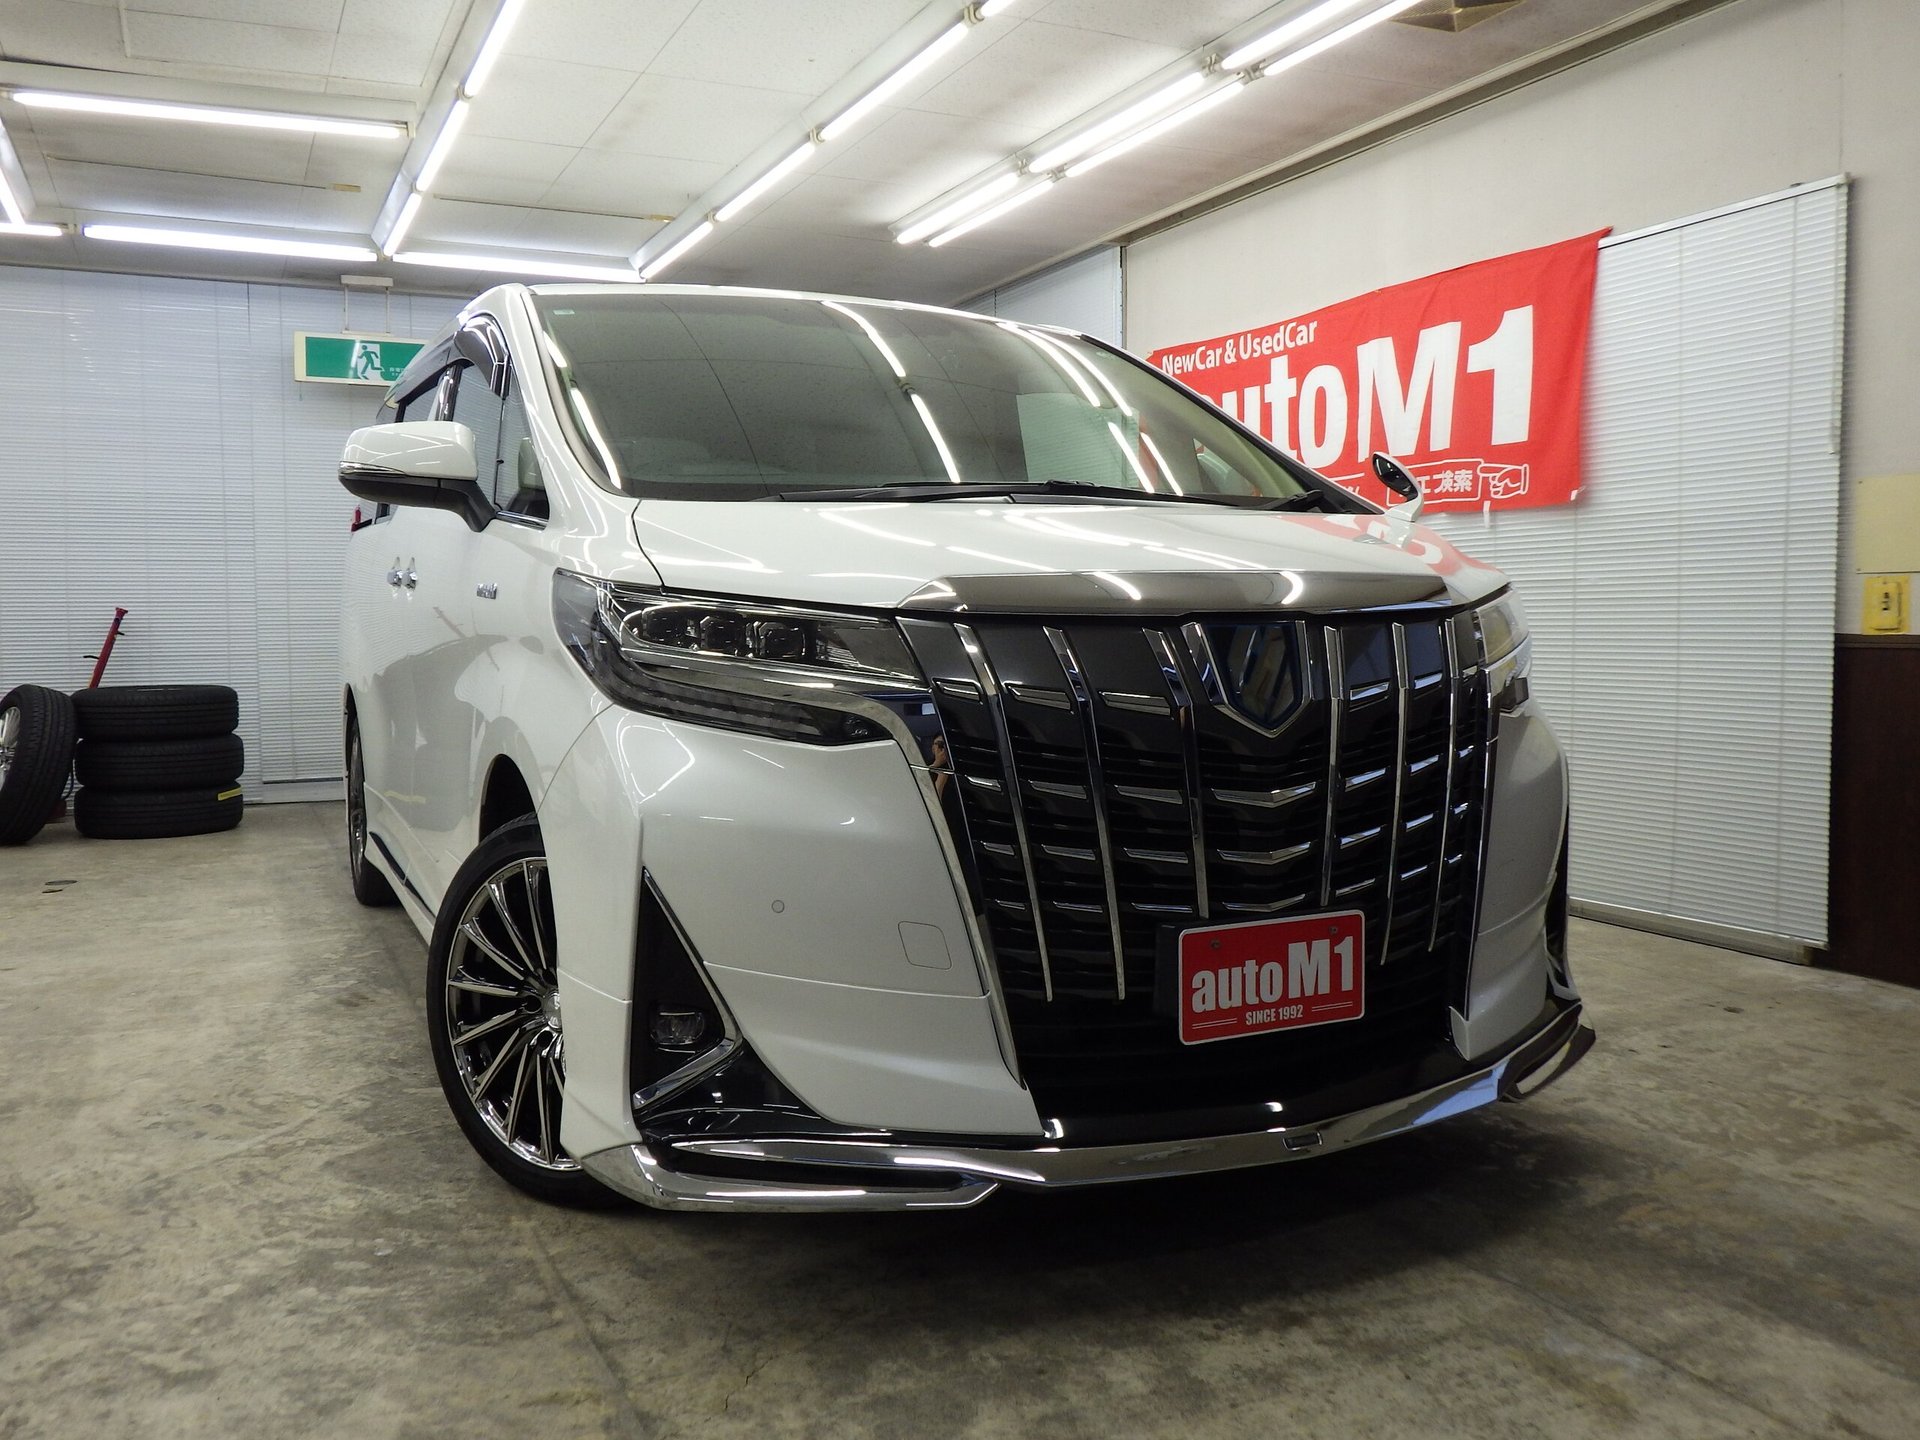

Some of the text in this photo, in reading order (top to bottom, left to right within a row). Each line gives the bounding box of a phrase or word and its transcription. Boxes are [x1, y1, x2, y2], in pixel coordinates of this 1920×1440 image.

[1223, 338, 1237, 365] &
[1238, 320, 1318, 361] UsedCar
[1245, 1004, 1304, 1026] SINCE 1992
